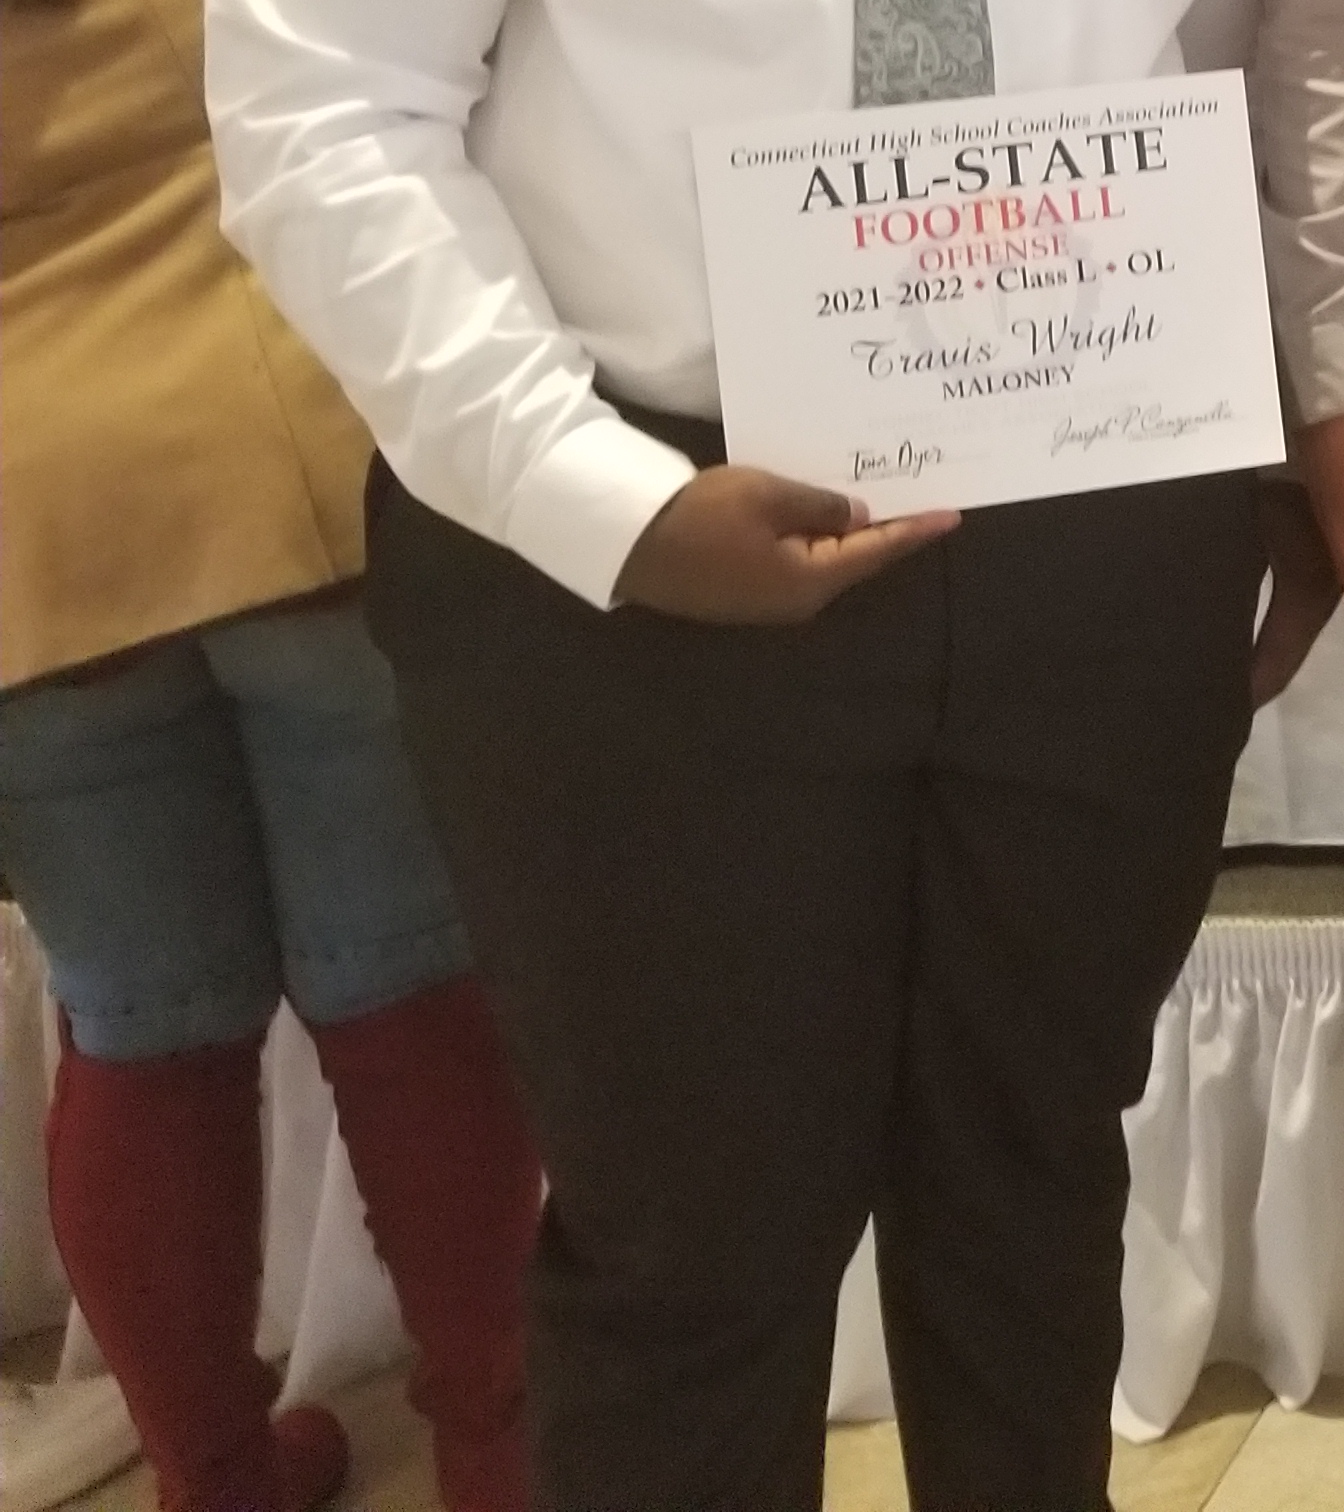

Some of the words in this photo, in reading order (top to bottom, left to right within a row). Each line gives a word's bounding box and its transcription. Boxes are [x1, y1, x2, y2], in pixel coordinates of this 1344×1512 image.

[730, 135, 860, 170] Connecticut
[869, 128, 922, 158] High
[929, 120, 1001, 146] School
[1007, 112, 1091, 138] Coaches
[1099, 98, 1218, 126] Association
[800, 126, 1168, 214] ALL-STATE
[853, 185, 1126, 249] FOOTBALL
[817, 277, 964, 317] 2021-2022
[996, 264, 1067, 294] Class
[1076, 257, 1096, 283] L
[1127, 248, 1175, 276] OL
[918, 233, 1069, 273] OFFENSE
[850, 336, 997, 380] Travis
[1011, 305, 1162, 360] Wright
[942, 364, 1076, 401] MALONEY
